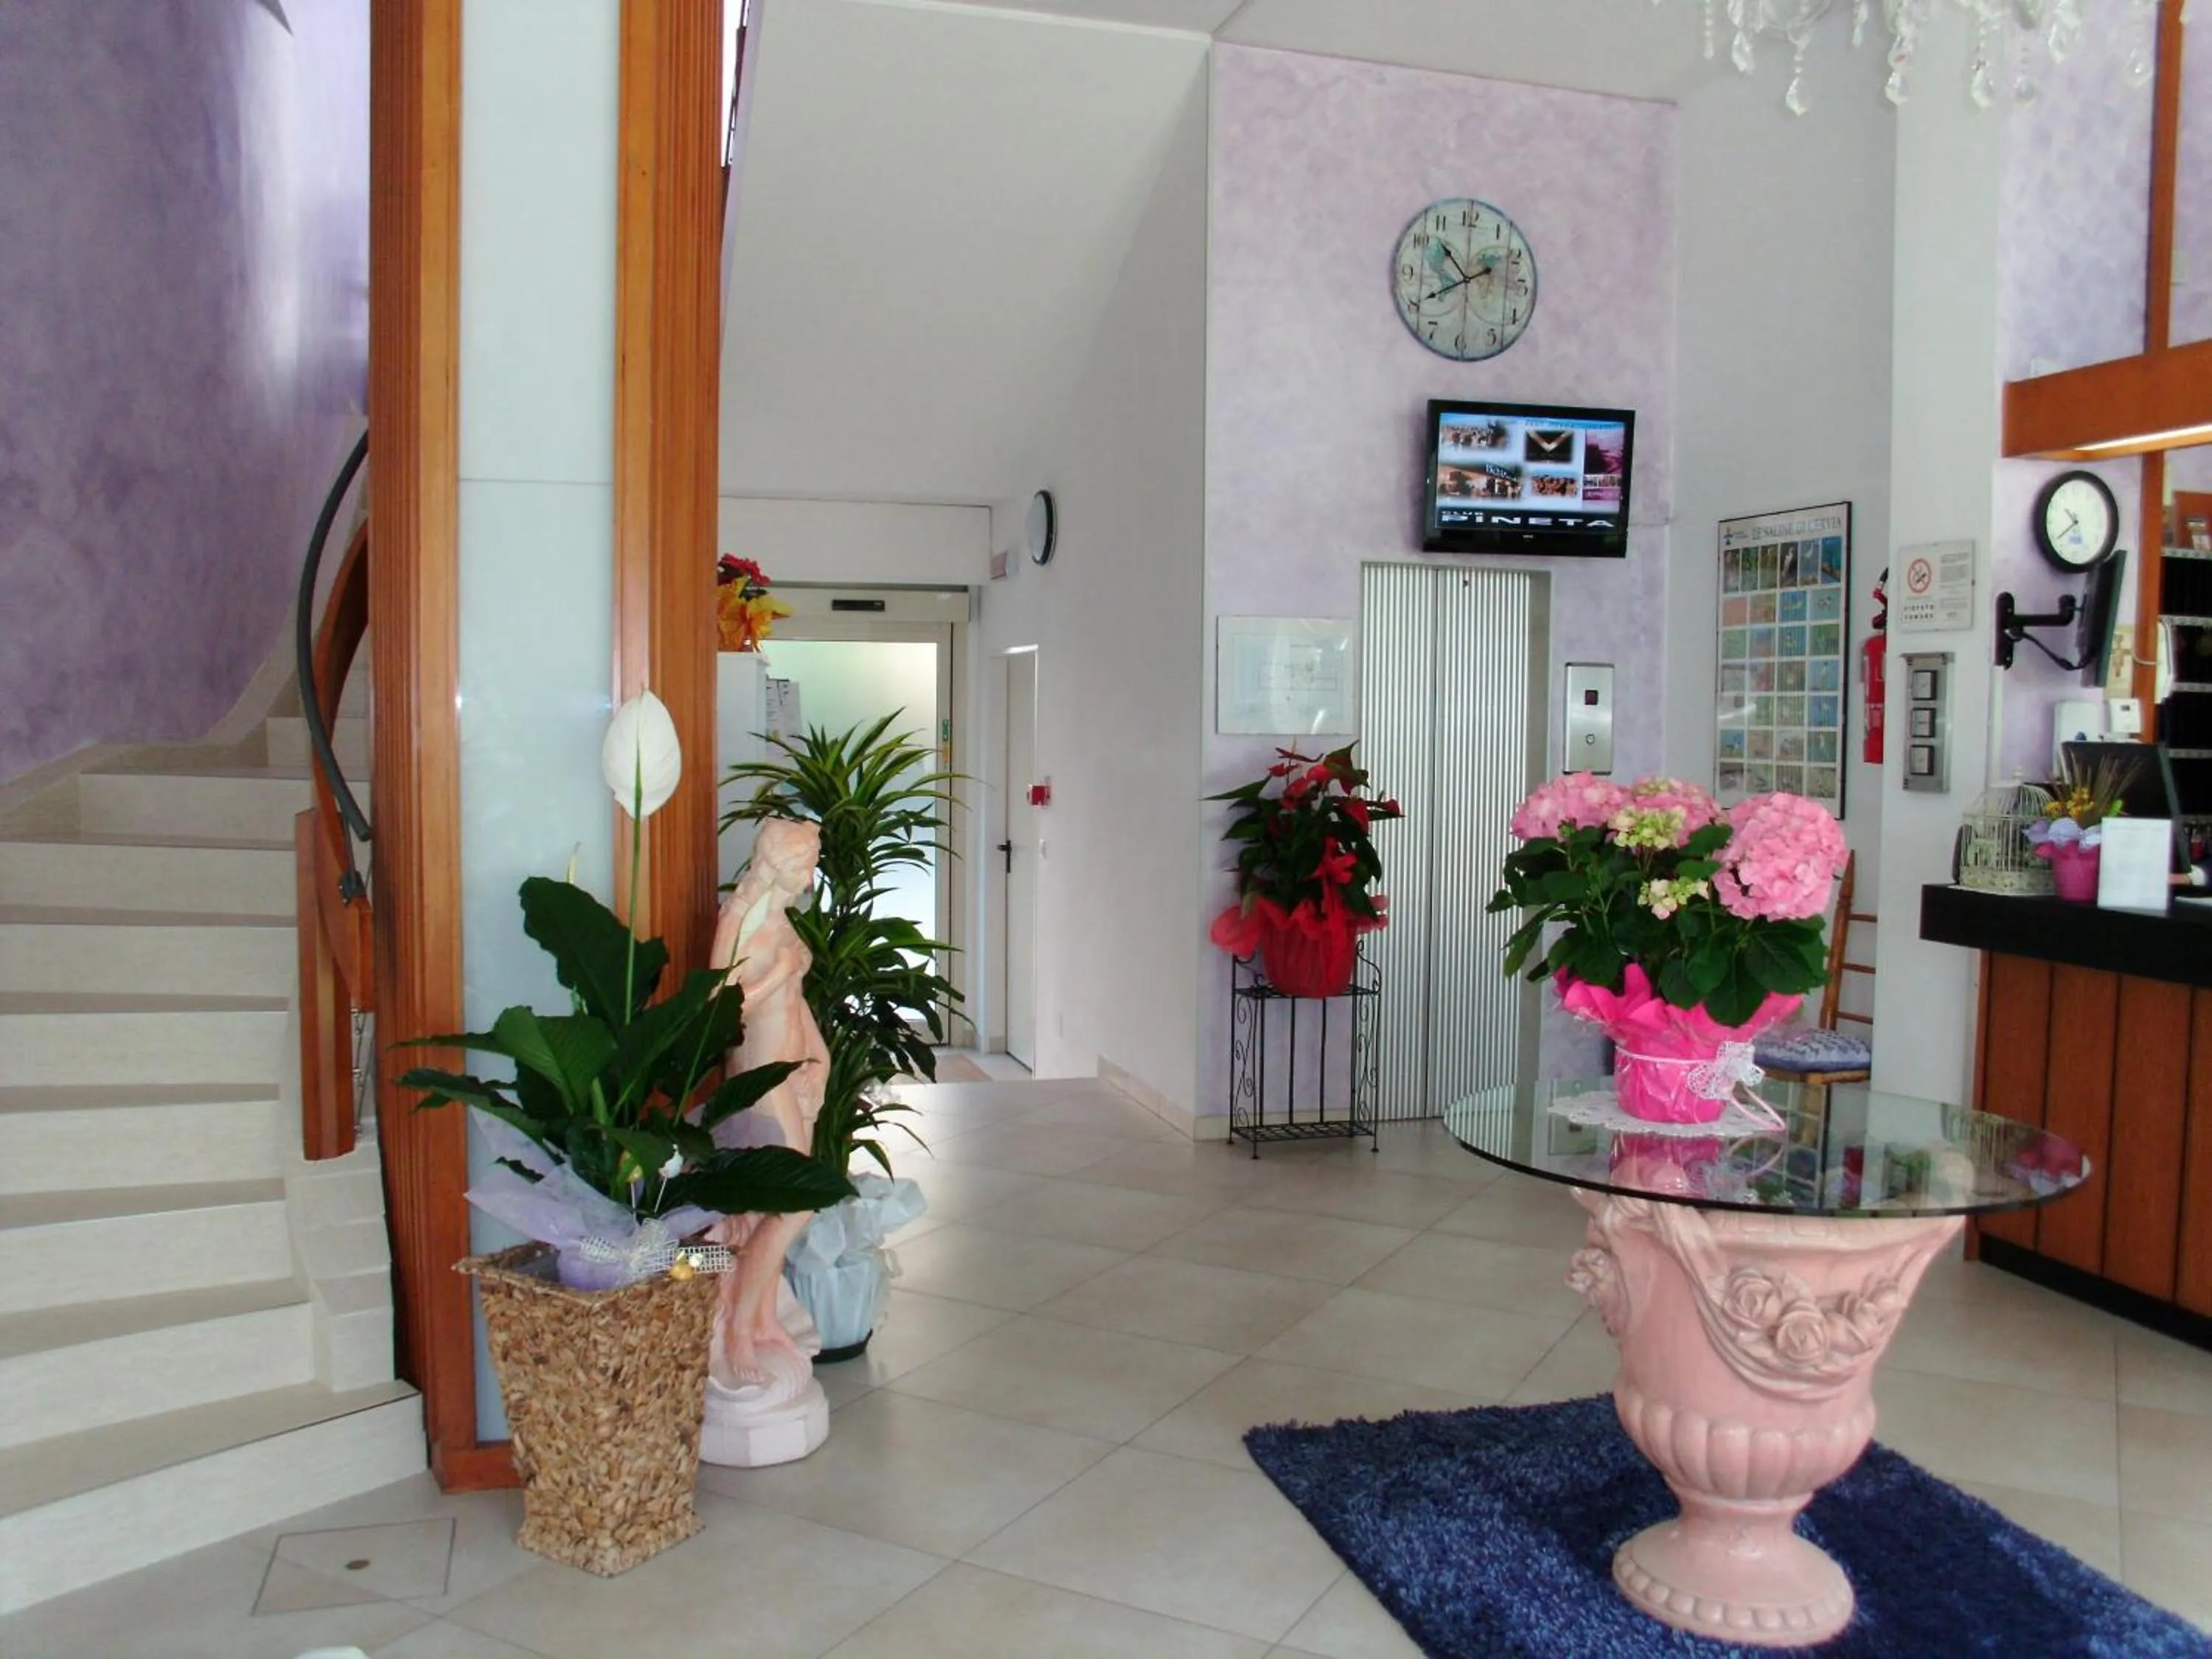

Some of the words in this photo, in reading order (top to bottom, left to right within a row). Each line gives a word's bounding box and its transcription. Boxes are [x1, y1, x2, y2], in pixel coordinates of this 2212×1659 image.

[1436, 215, 1446, 232] 11
[1462, 211, 1480, 228] 12
[1413, 233, 1430, 248] 10
[1510, 248, 1522, 265] 2
[1402, 265, 1413, 280] 9
[1517, 278, 1528, 296] 3
[1427, 321, 1438, 340] 7
[1487, 328, 1496, 345] 5
[1455, 334, 1467, 352] 6
[1441, 514, 1615, 528] PINETA
